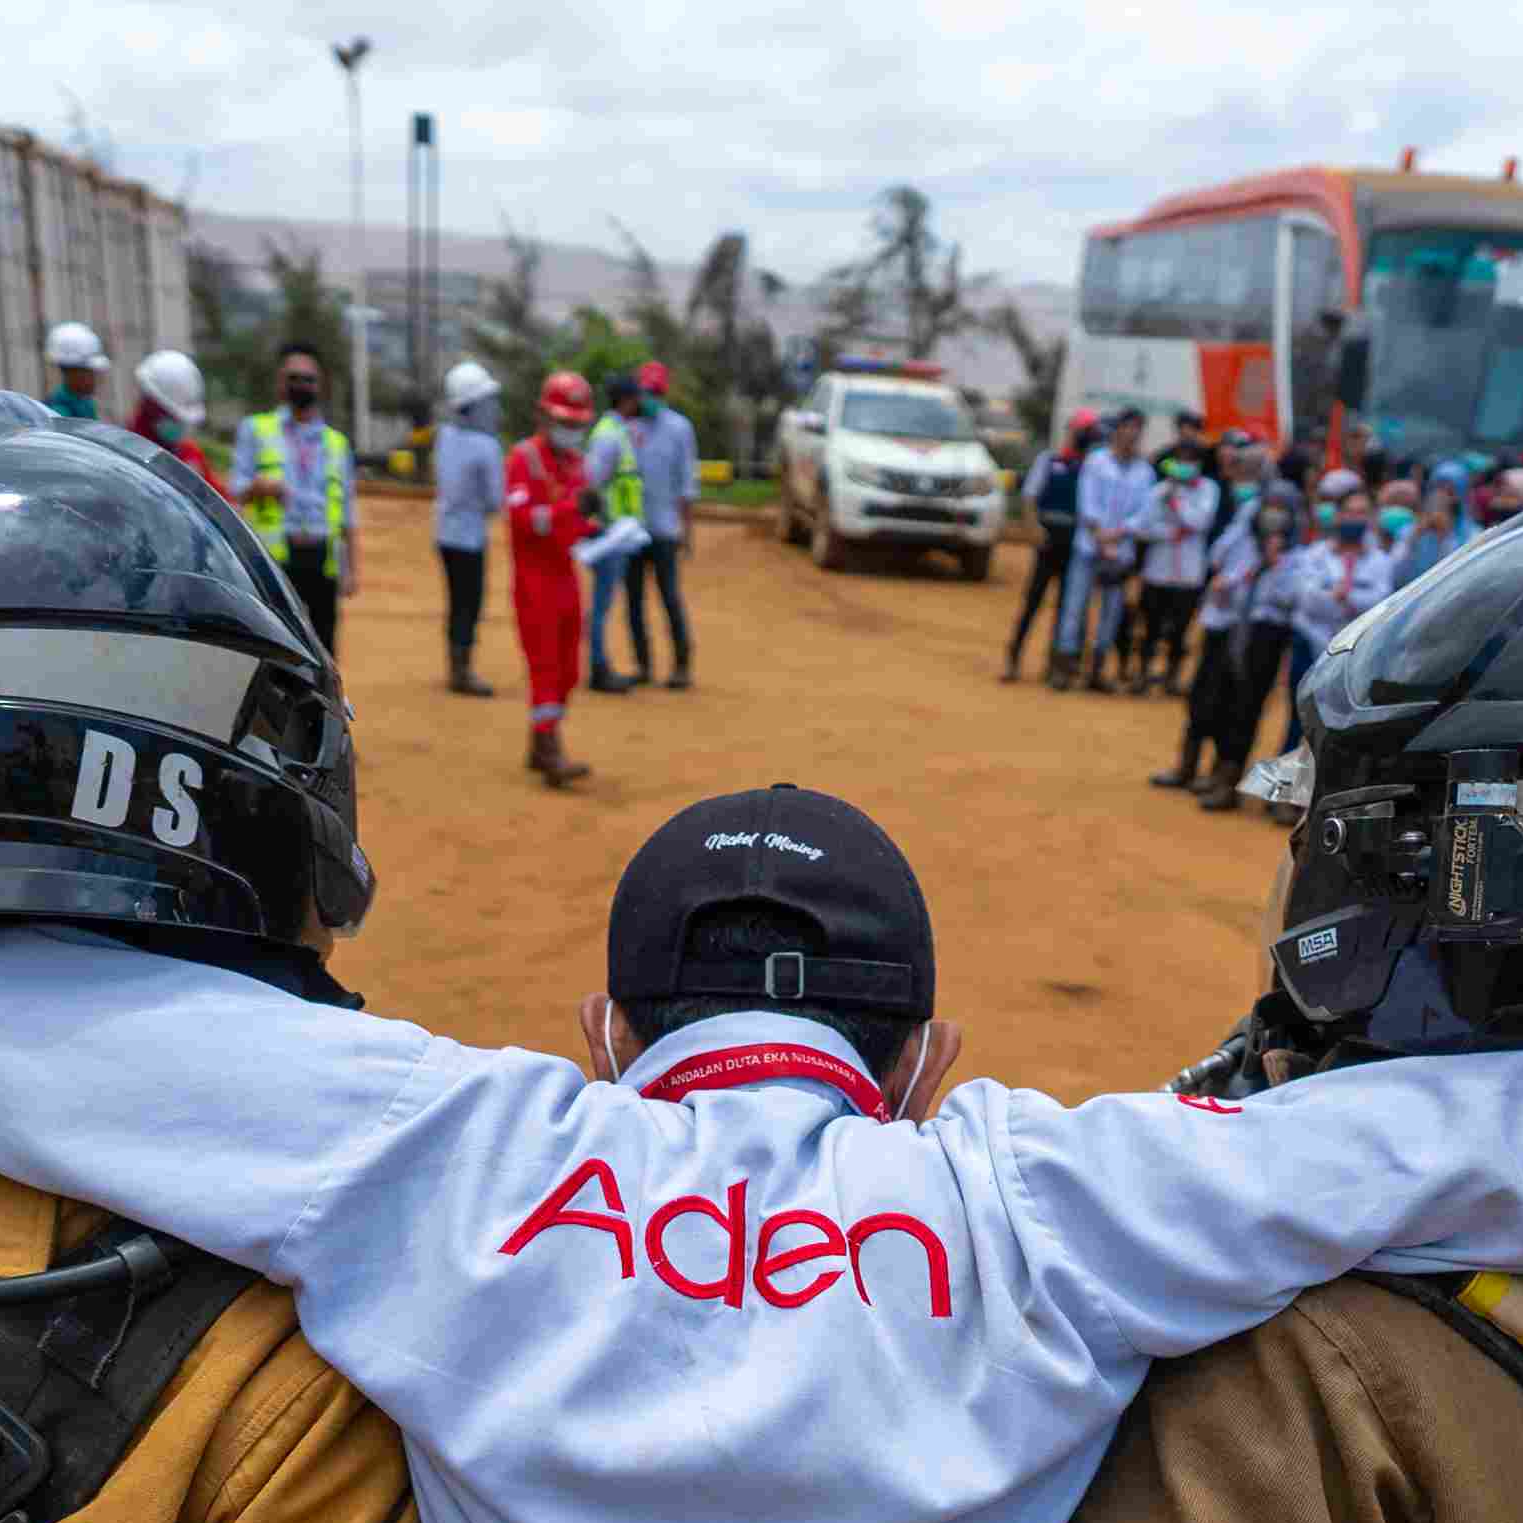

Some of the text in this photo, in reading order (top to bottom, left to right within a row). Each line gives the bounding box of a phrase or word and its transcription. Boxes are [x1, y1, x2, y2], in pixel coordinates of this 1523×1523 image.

[704, 832, 825, 861] Nickel Mining
[1448, 819, 1469, 916] NIGHTSTICK
[1300, 931, 1336, 956] MSA
[670, 1061, 723, 1087] ANDALAN
[727, 1053, 762, 1070] DUTA
[763, 1052, 790, 1063] EKA
[497, 1158, 953, 1319] Aden
